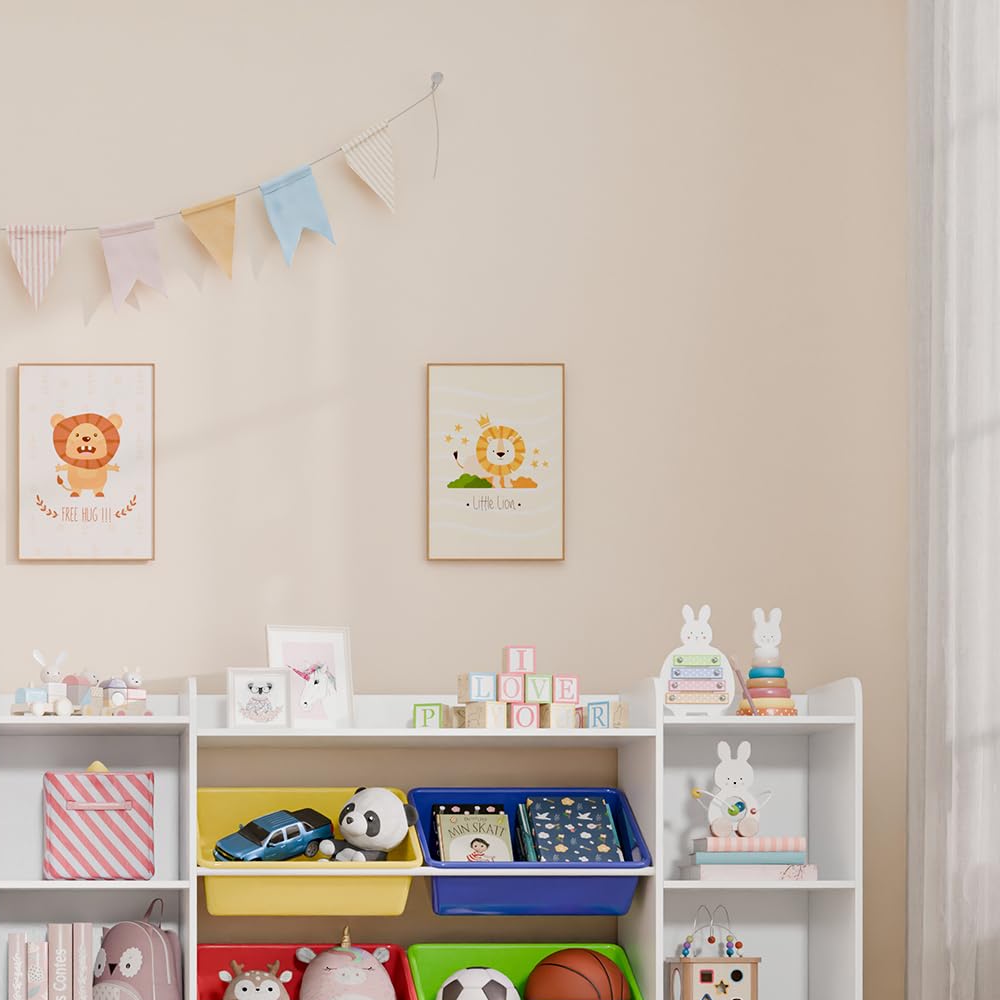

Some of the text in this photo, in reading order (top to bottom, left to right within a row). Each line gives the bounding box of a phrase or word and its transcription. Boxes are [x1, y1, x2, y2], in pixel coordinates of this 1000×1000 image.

[472, 496, 516, 511] Little Lion
[61, 507, 79, 522] FREE
[81, 507, 98, 522] HUG
[516, 649, 528, 671] I
[475, 676, 575, 700] LOVE
[421, 708, 436, 728] P
[447, 823, 470, 839] MIN
[53, 948, 67, 992] Contes
